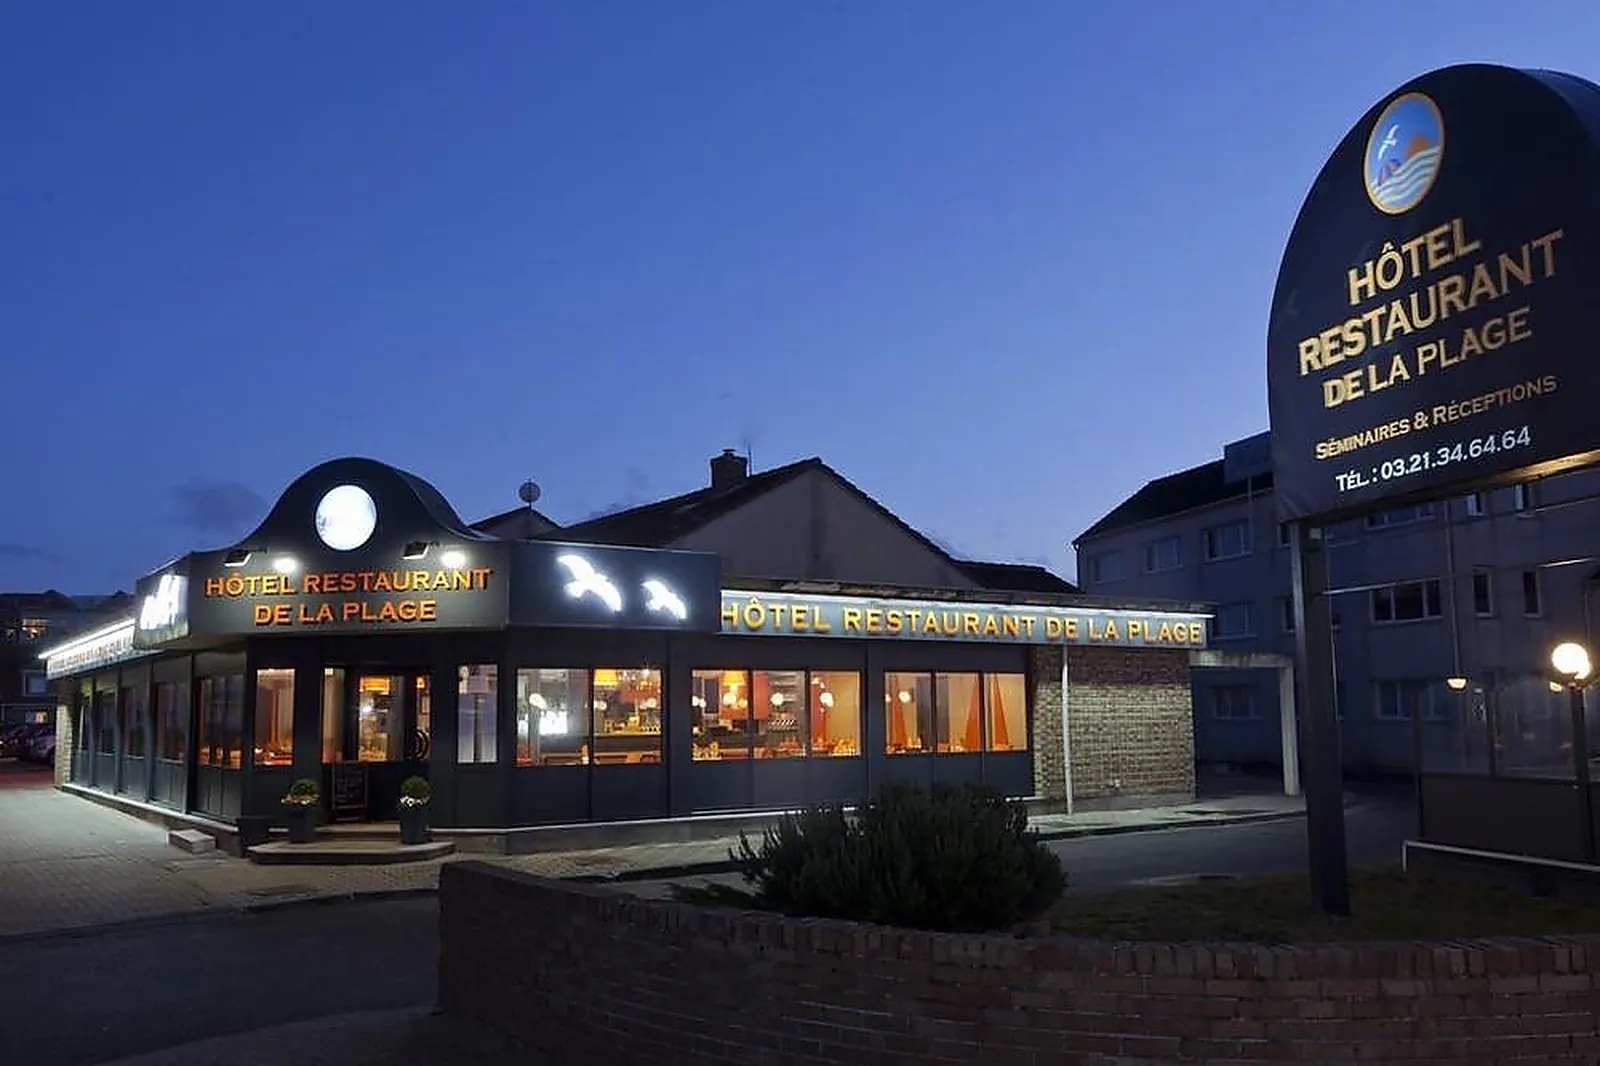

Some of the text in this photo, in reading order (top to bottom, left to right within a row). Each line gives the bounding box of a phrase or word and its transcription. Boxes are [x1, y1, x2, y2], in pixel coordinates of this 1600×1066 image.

[1348, 218, 1480, 305] HÔTEL
[1298, 228, 1564, 375] RESTAURANT
[1323, 307, 1532, 408] DE LA PLAGE
[1316, 375, 1557, 459] SÉMINAIRES & RÉCEPTIONS
[1381, 425, 1530, 479] 03.21.34.64.64
[205, 567, 491, 597] HÔTEL RESTAURANT
[254, 600, 437, 626] DE LA PLAGE
[843, 607, 1036, 639] RESTAURANT
[1046, 617, 1079, 640] DE
[1088, 619, 1121, 642] LA
[1127, 620, 1203, 645] PLAGE
